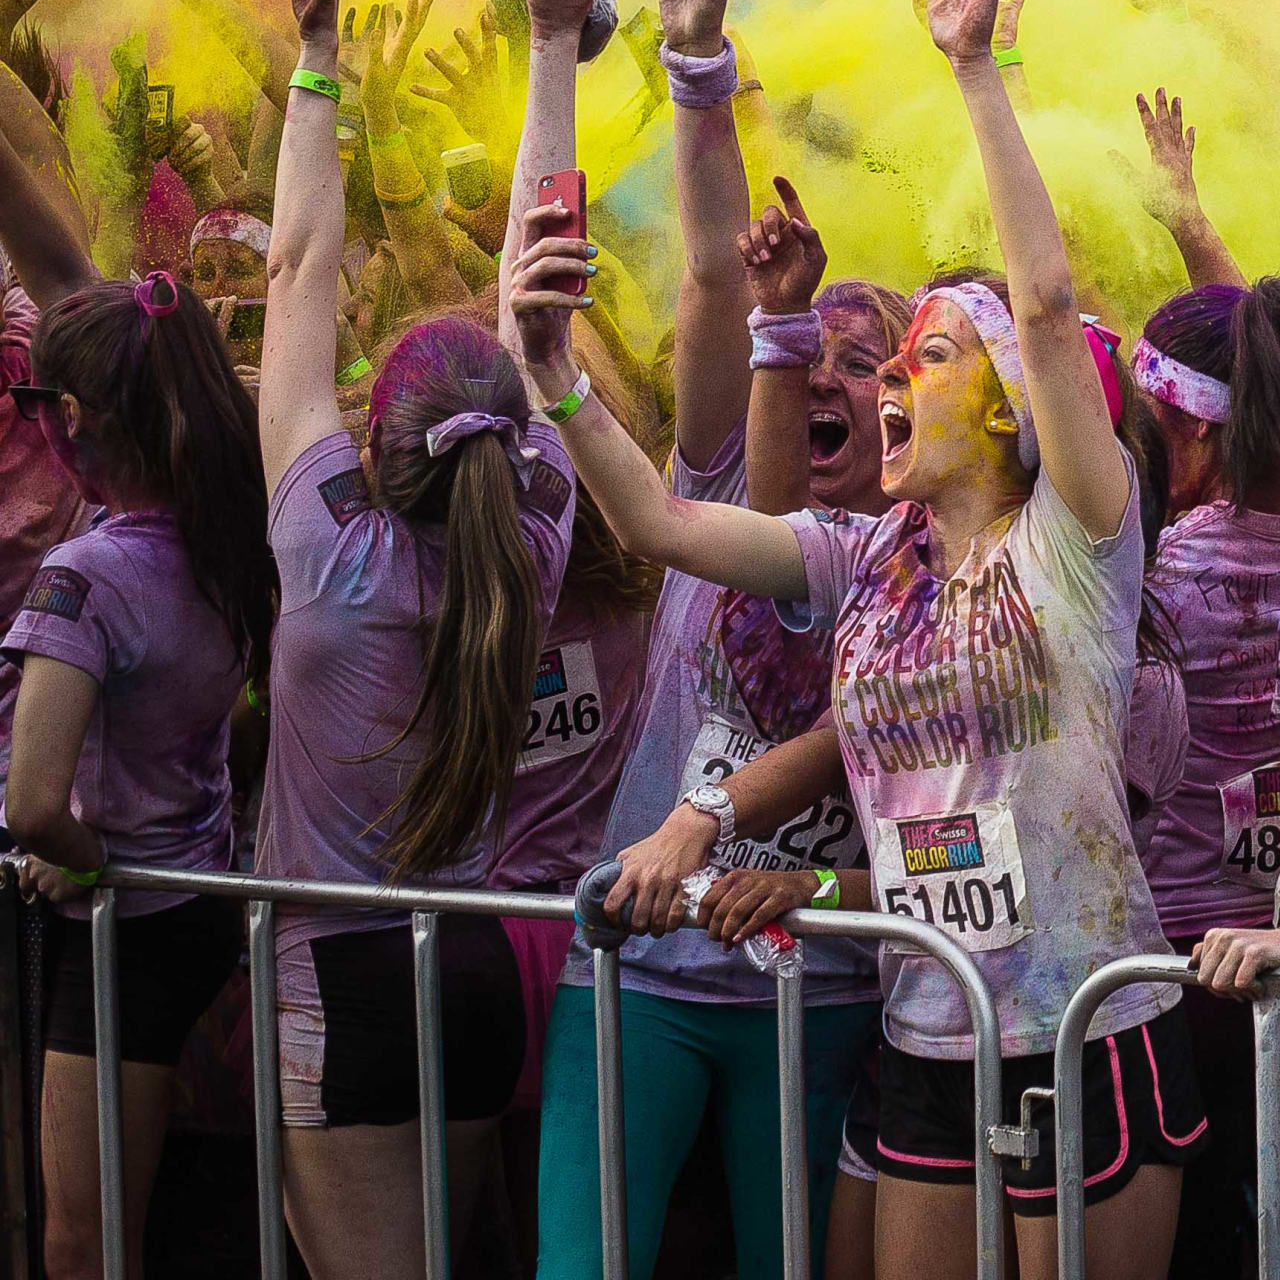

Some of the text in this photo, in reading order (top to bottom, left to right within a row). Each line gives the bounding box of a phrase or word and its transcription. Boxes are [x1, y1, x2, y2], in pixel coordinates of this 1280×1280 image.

[1193, 566, 1280, 613] FRUIT
[853, 644, 1050, 728] COLOR RUN
[722, 729, 762, 763] THE
[866, 711, 974, 775] COLOR
[901, 825, 967, 849] THE Swisse
[884, 872, 1020, 933] 51401
